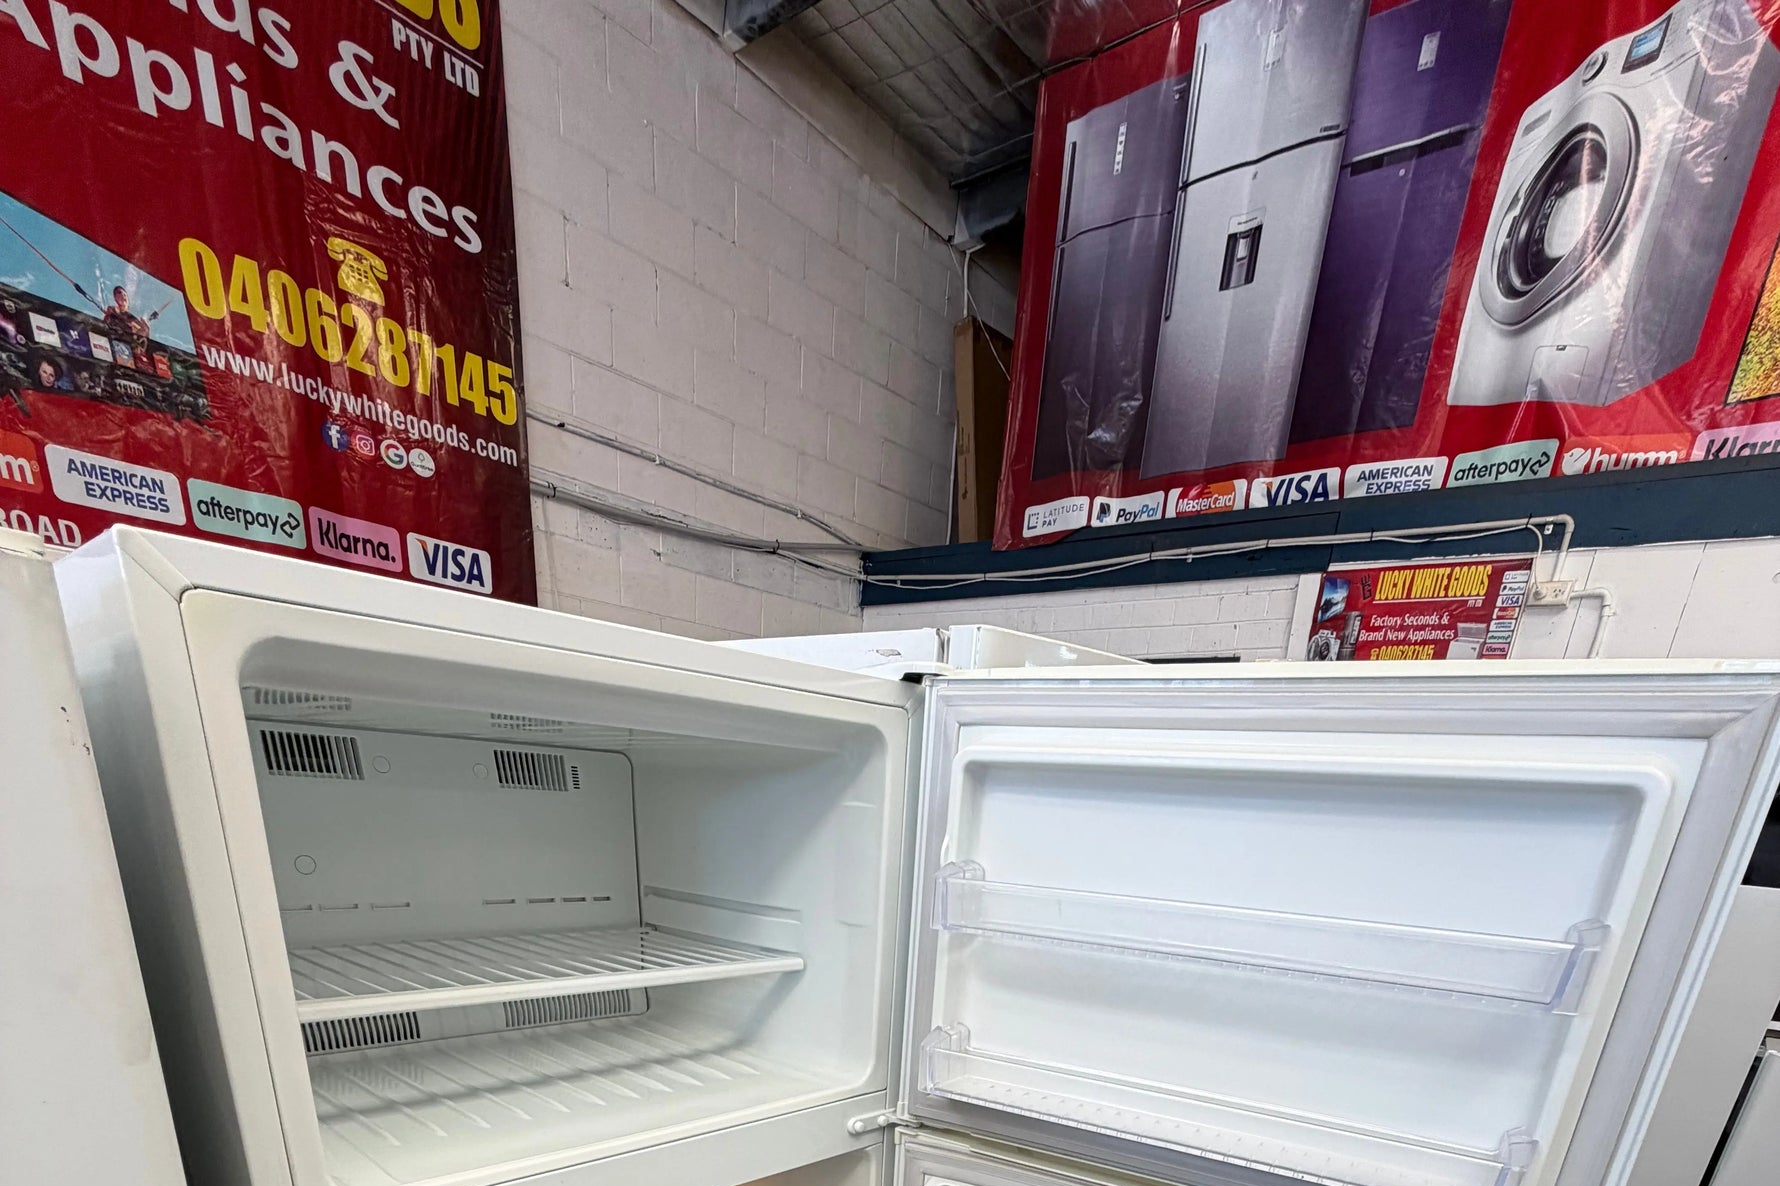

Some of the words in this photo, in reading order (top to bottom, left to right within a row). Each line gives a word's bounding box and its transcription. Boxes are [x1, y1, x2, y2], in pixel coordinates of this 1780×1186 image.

[391, 18, 434, 70] PTY
[443, 51, 480, 97] LTD
[328, 40, 400, 130] &
[178, 237, 517, 426] 0406287145
[201, 344, 518, 468] www.luckywhitegoods.com
[1357, 464, 1434, 482] AMERICAN
[1453, 456, 1531, 482] afterpay
[1588, 446, 1678, 474] humm
[66, 458, 166, 495] AMERICAN
[1265, 472, 1330, 507] VISA
[1365, 479, 1432, 495] EXPRESS
[84, 481, 171, 513] EXPRESS
[1043, 503, 1085, 518] LATITUDE
[1176, 490, 1235, 513] MasterCard
[197, 497, 280, 536] afterpay
[1041, 517, 1058, 528] PAY
[1116, 501, 1160, 523] PayPal
[421, 540, 486, 587] VISA
[1374, 569, 1415, 601] LUCKY
[1411, 567, 1452, 599] WHITE
[1447, 564, 1492, 598] GOODS
[1501, 595, 1520, 606] VISA
[1370, 614, 1402, 628] Factory
[1404, 613, 1439, 626] Seconds
[1440, 612, 1450, 625] &
[1360, 629, 1384, 642] Brand
[1386, 628, 1406, 641] New
[1407, 628, 1455, 643] Appliances
